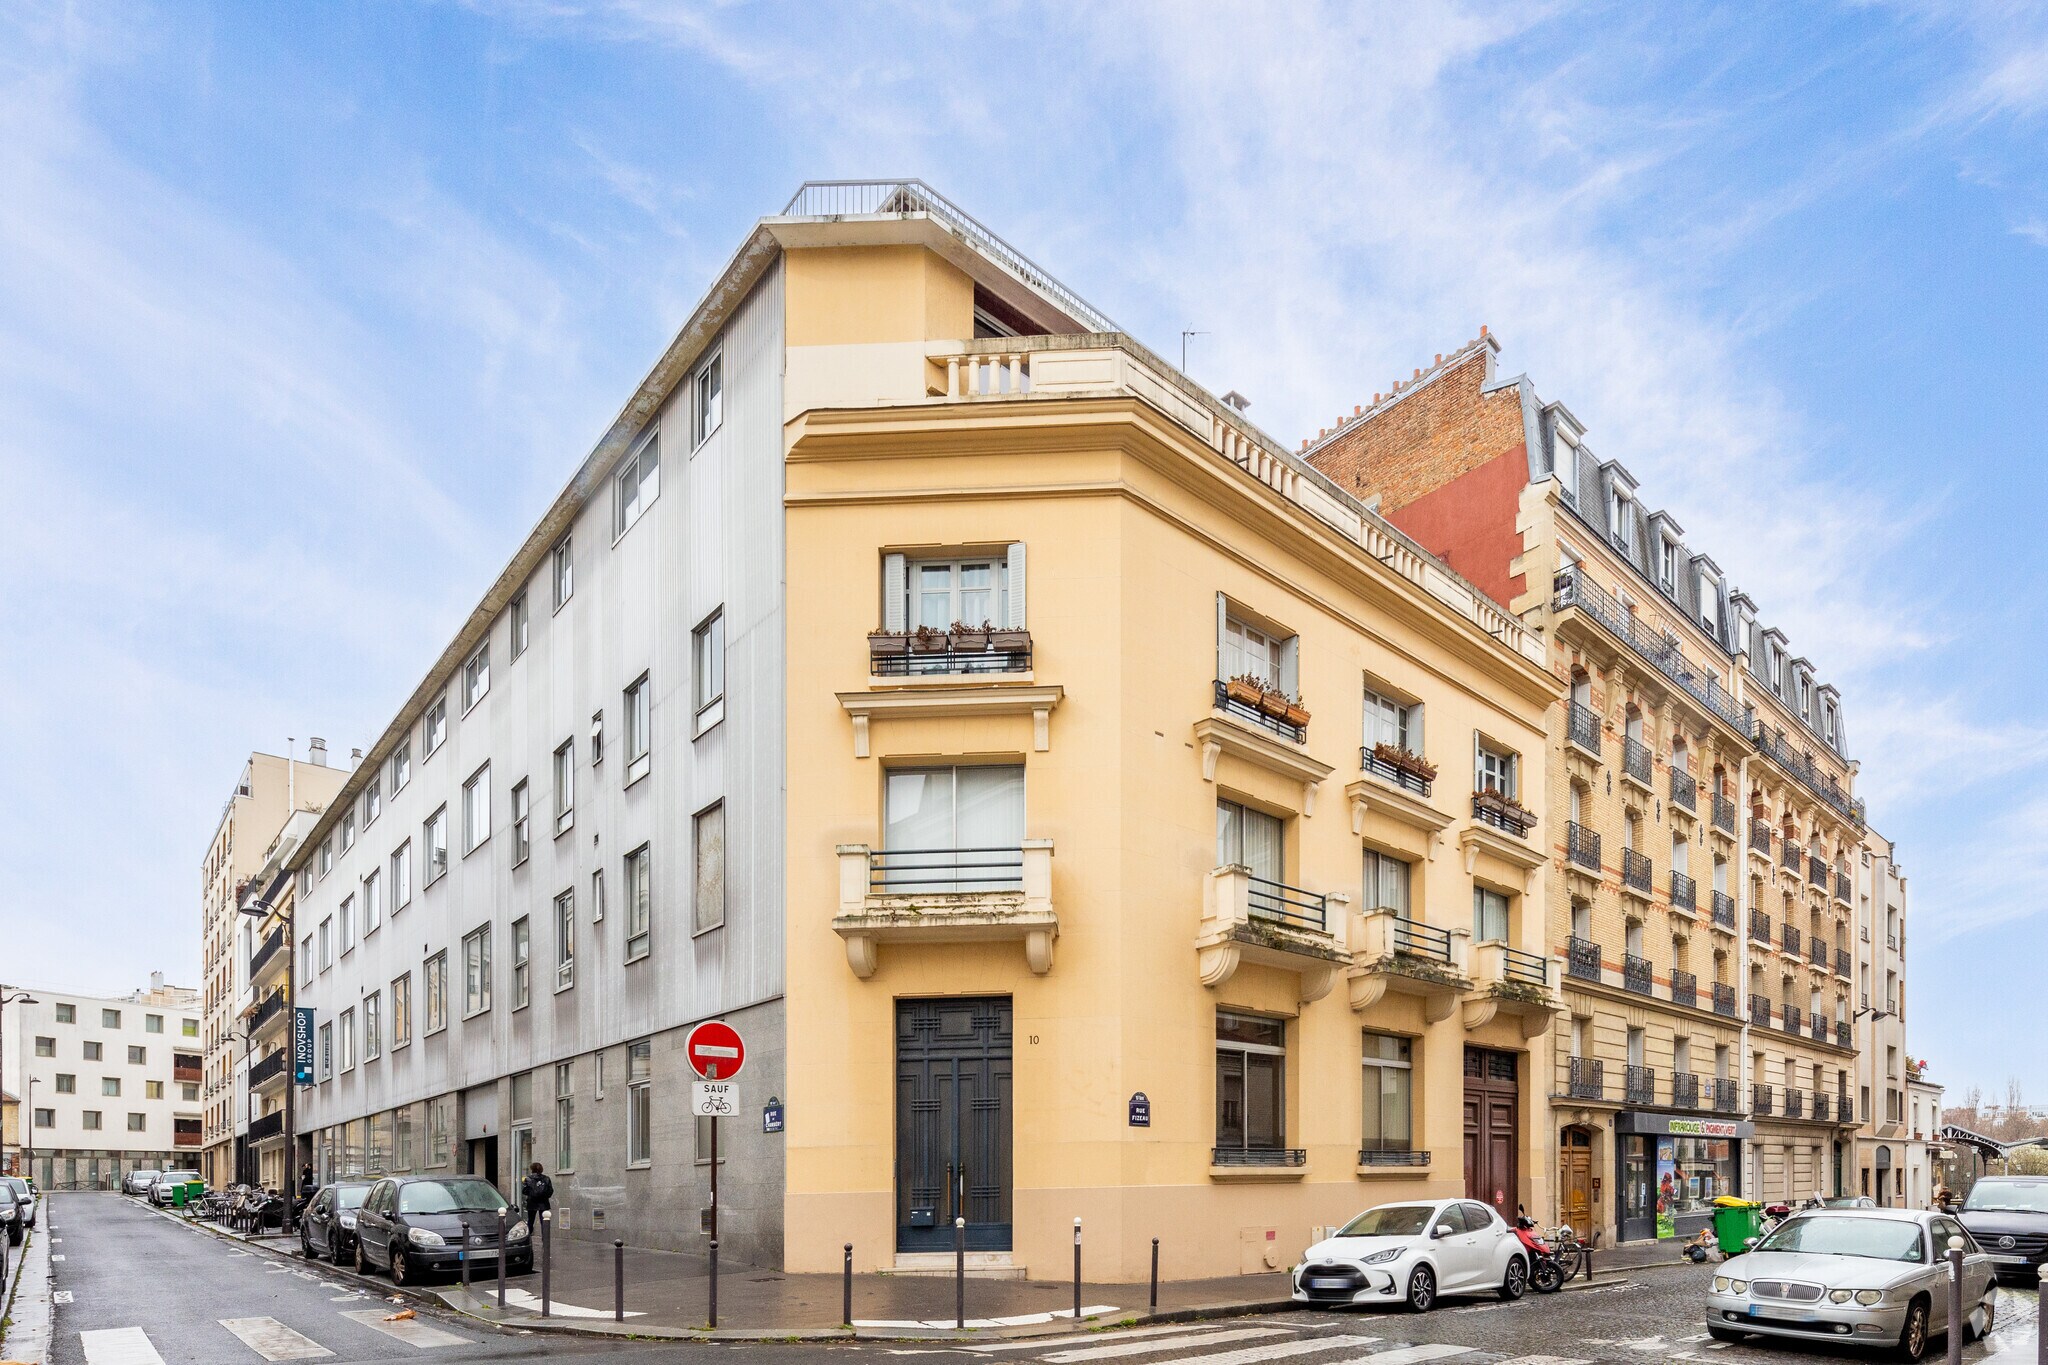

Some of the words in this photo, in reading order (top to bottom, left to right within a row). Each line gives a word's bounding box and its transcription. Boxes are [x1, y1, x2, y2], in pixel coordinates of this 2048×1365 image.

[297, 1012, 306, 1063] INOVSHOP
[1029, 1035, 1040, 1045] 10
[704, 1084, 729, 1093] SAUF
[1669, 1120, 1700, 1134] INFRAROUGE
